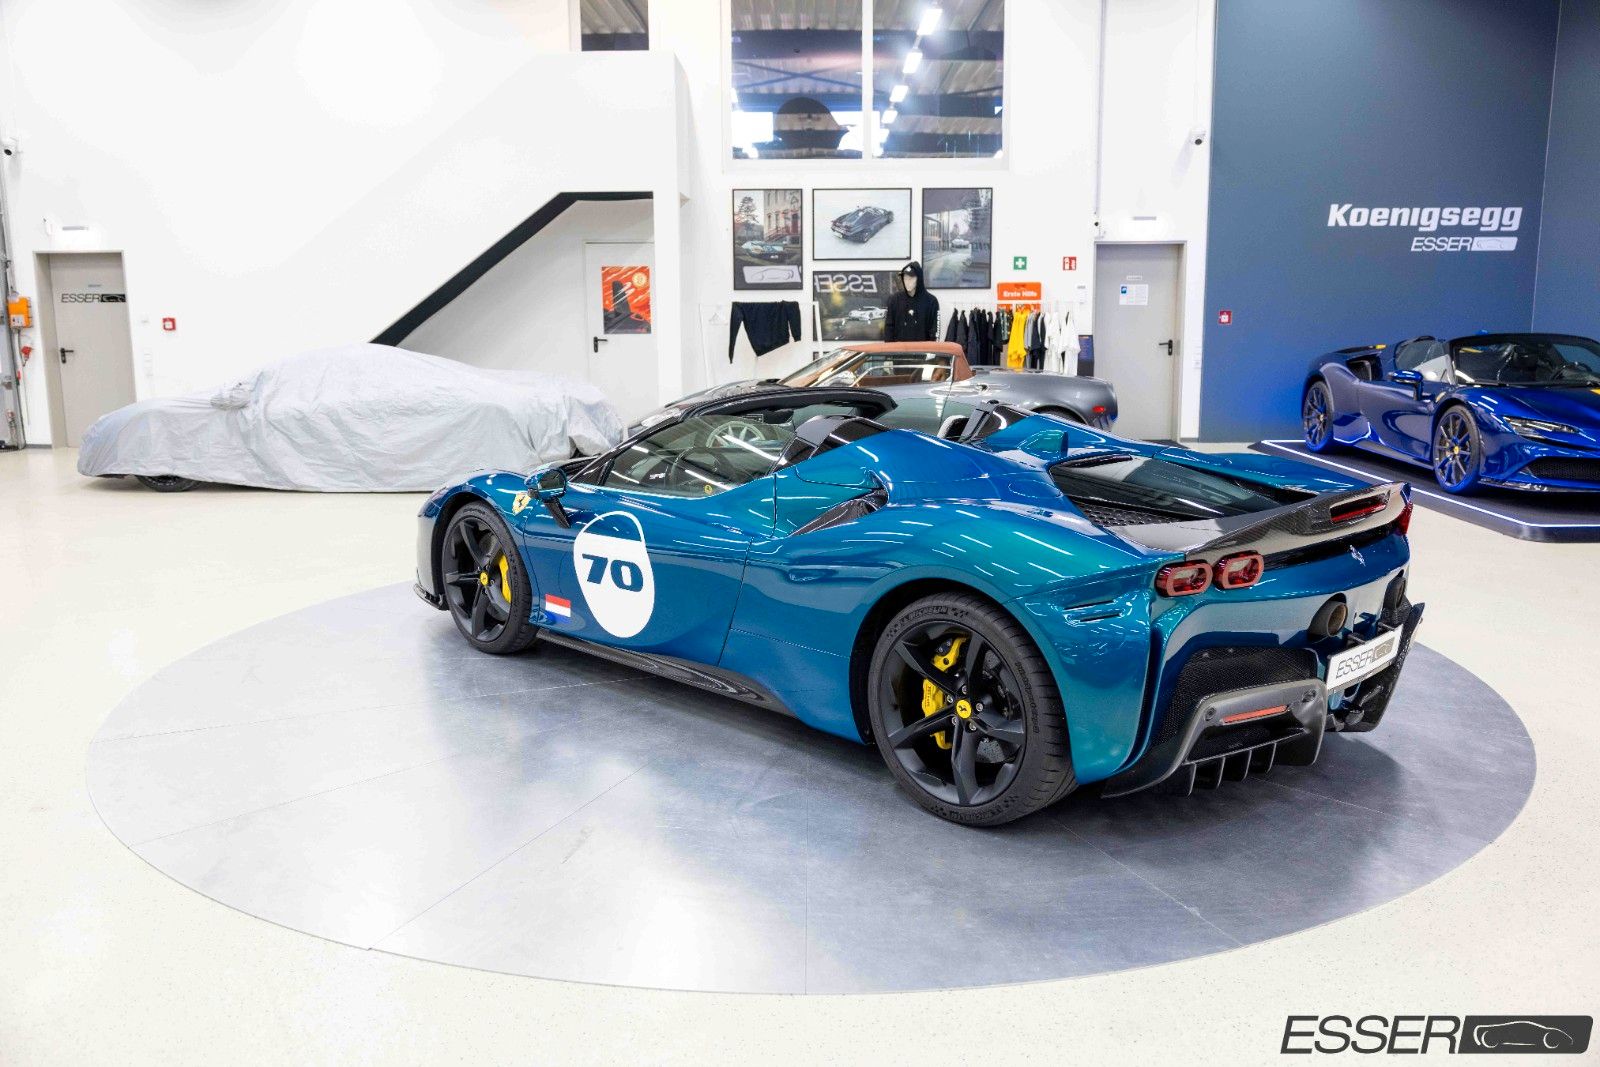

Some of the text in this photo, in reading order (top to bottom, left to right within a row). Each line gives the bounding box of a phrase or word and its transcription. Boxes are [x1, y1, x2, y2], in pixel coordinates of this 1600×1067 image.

[1327, 203, 1523, 232] Koenigsegg
[1410, 237, 1471, 252] ESSER
[61, 293, 102, 303] ESSER
[581, 553, 644, 593] 70
[1336, 648, 1374, 679] ESSER
